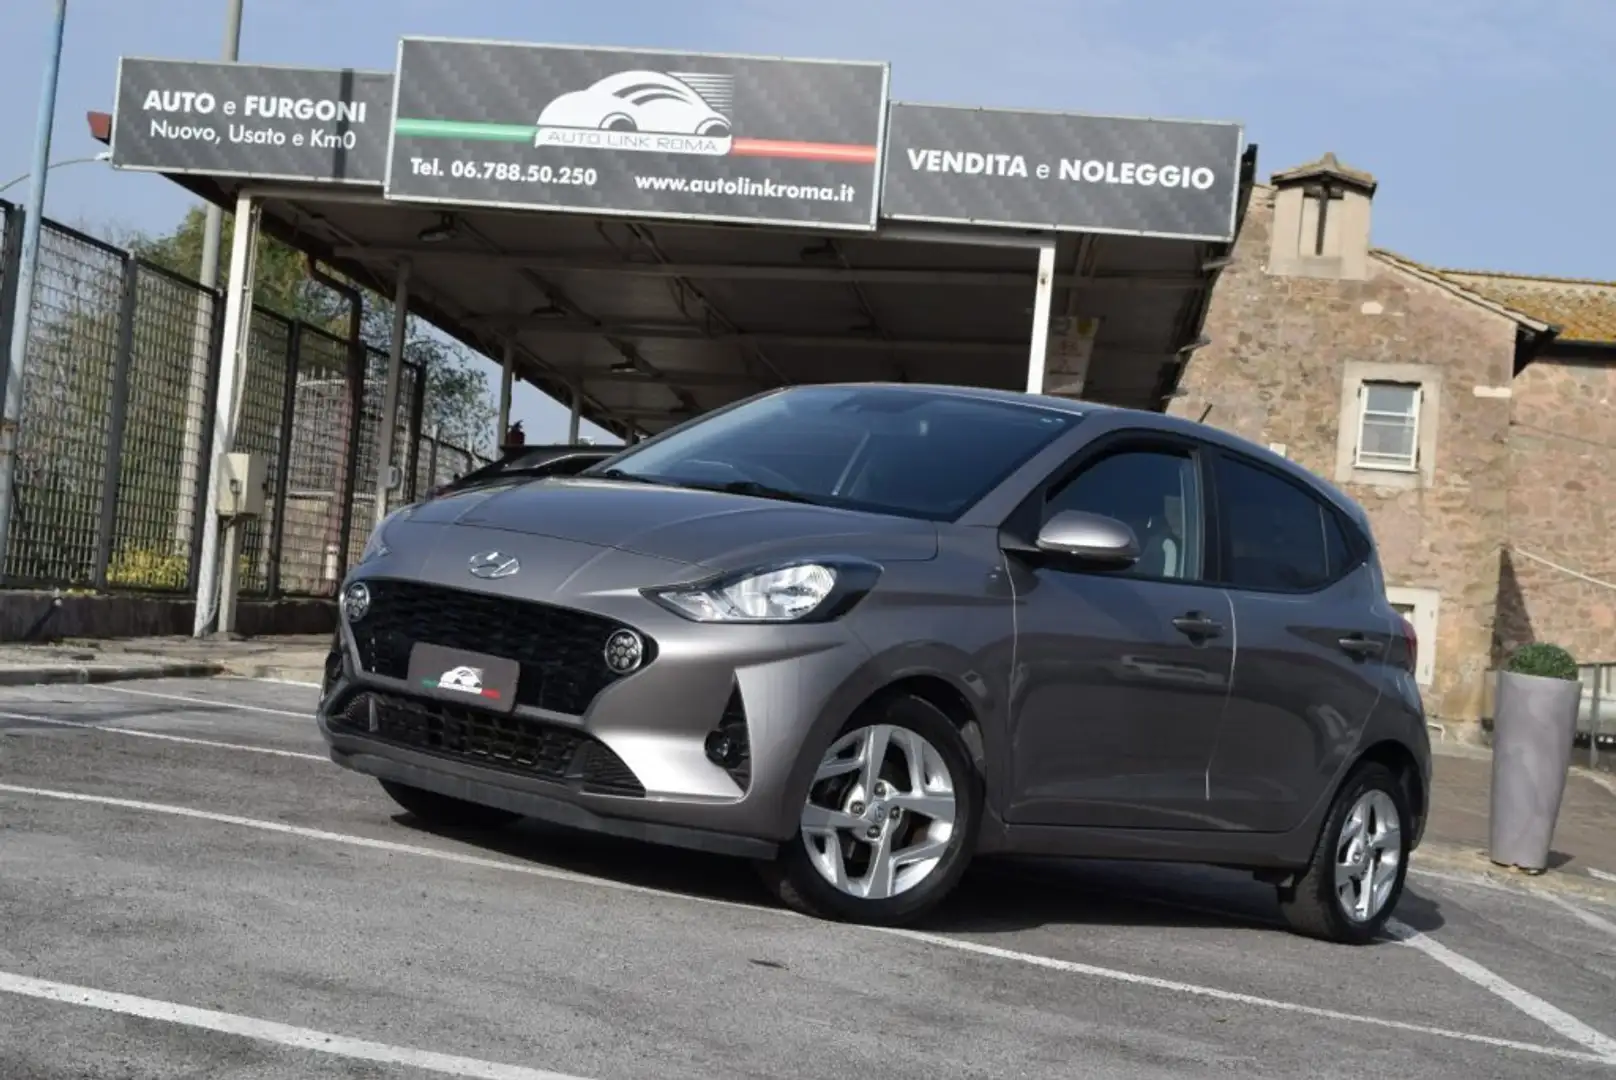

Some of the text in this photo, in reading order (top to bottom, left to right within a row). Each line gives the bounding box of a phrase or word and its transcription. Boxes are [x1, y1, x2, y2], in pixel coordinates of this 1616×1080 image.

[143, 90, 367, 123] AUTO e FURGONI
[149, 120, 221, 144] Nuovo,
[228, 124, 286, 145] Usato
[292, 133, 304, 146] e
[548, 129, 718, 153] AUTO LINK ROMA
[411, 157, 598, 186] Tel. 06.788.50.250
[907, 148, 1215, 190] VENDITA e NOLEGGIO
[634, 173, 856, 203] www.autolinkroma.it
